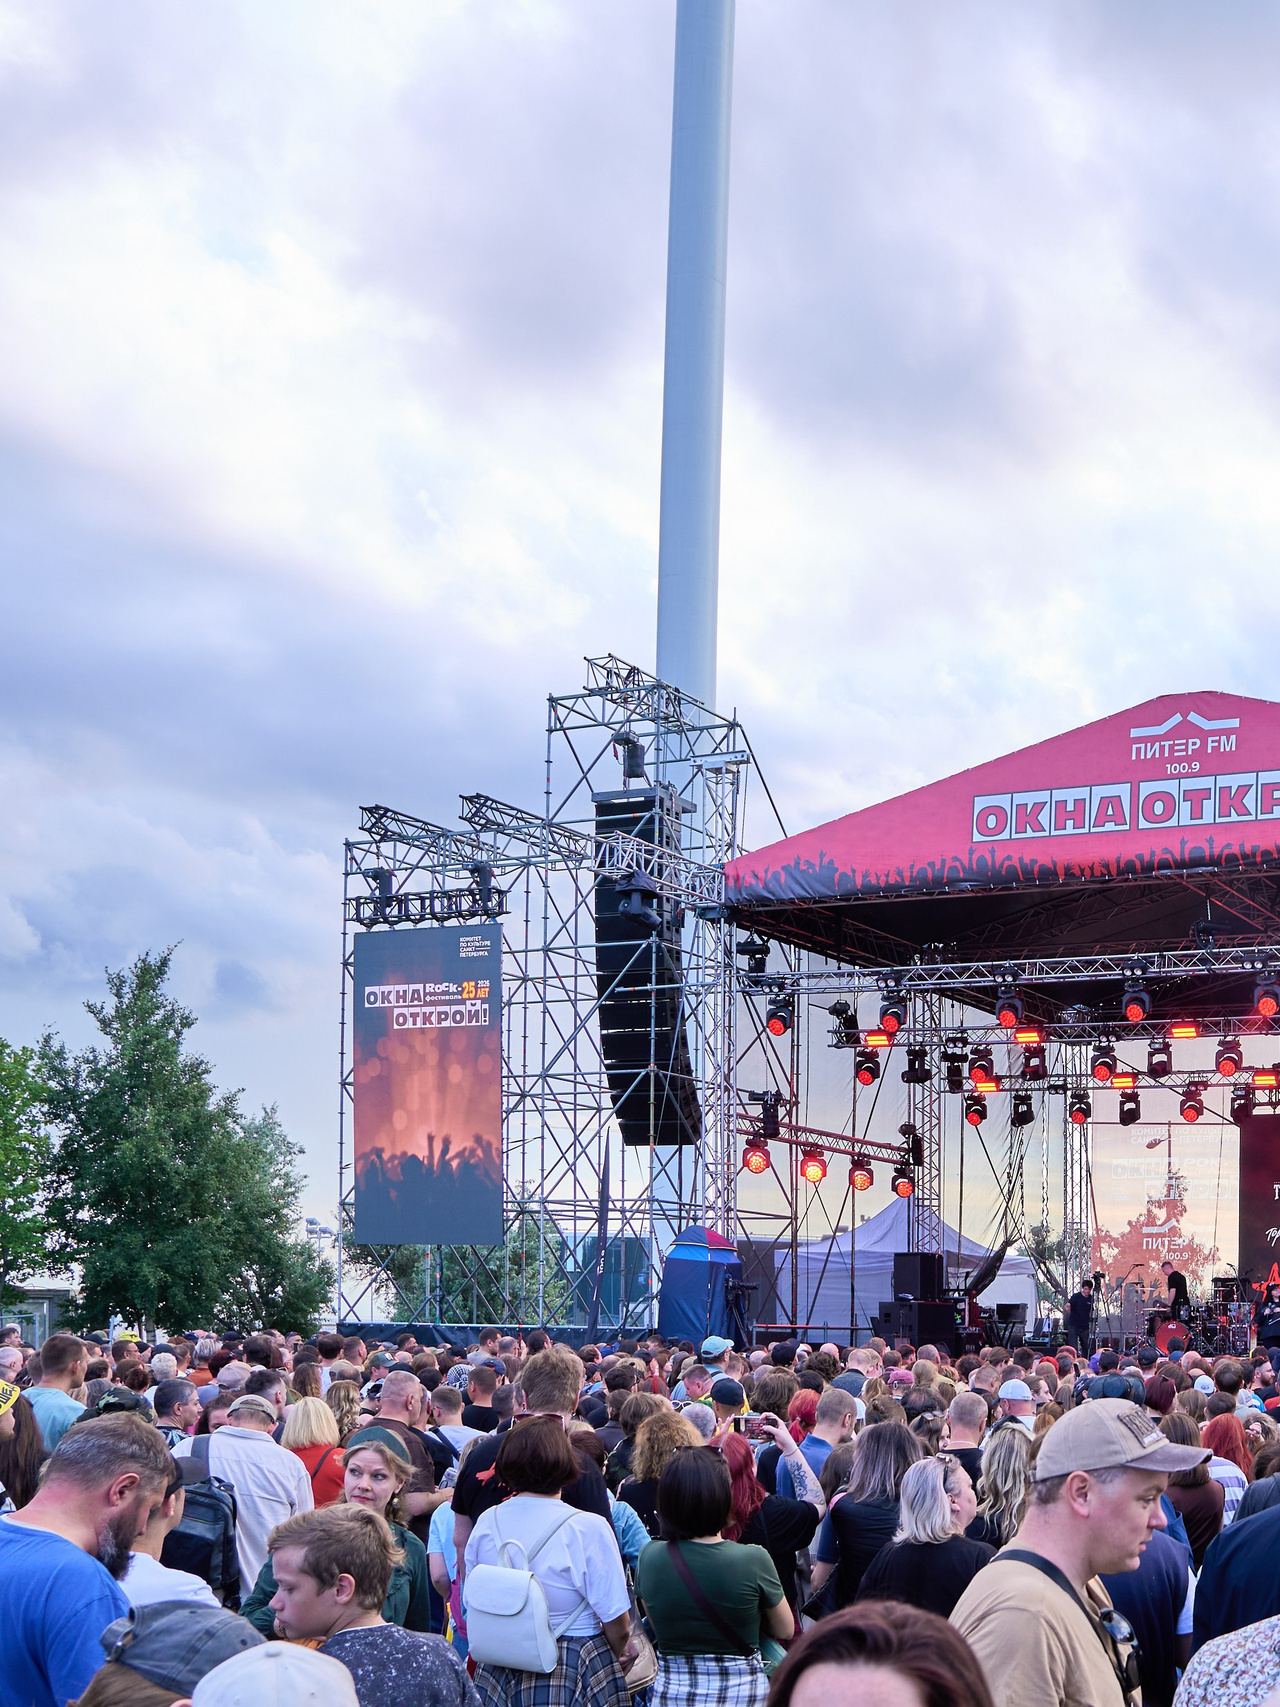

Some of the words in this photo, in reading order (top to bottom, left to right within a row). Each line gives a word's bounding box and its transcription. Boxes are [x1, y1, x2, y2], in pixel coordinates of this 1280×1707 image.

[1131, 739, 1201, 761] ПИТЕР
[1207, 734, 1238, 754] FM
[1165, 760, 1200, 775] 100.9
[974, 793, 1128, 838] ОКНА
[366, 988, 423, 1006] ОКНА
[425, 994, 462, 1002] фестиваль
[462, 981, 476, 999] 25
[476, 987, 490, 998] ЛЕТ
[394, 1001, 489, 1027] ОТКРОЙ!
[1131, 1127, 1173, 1135] КОМИТЕ
[1165, 1252, 1189, 1260] 100.9
